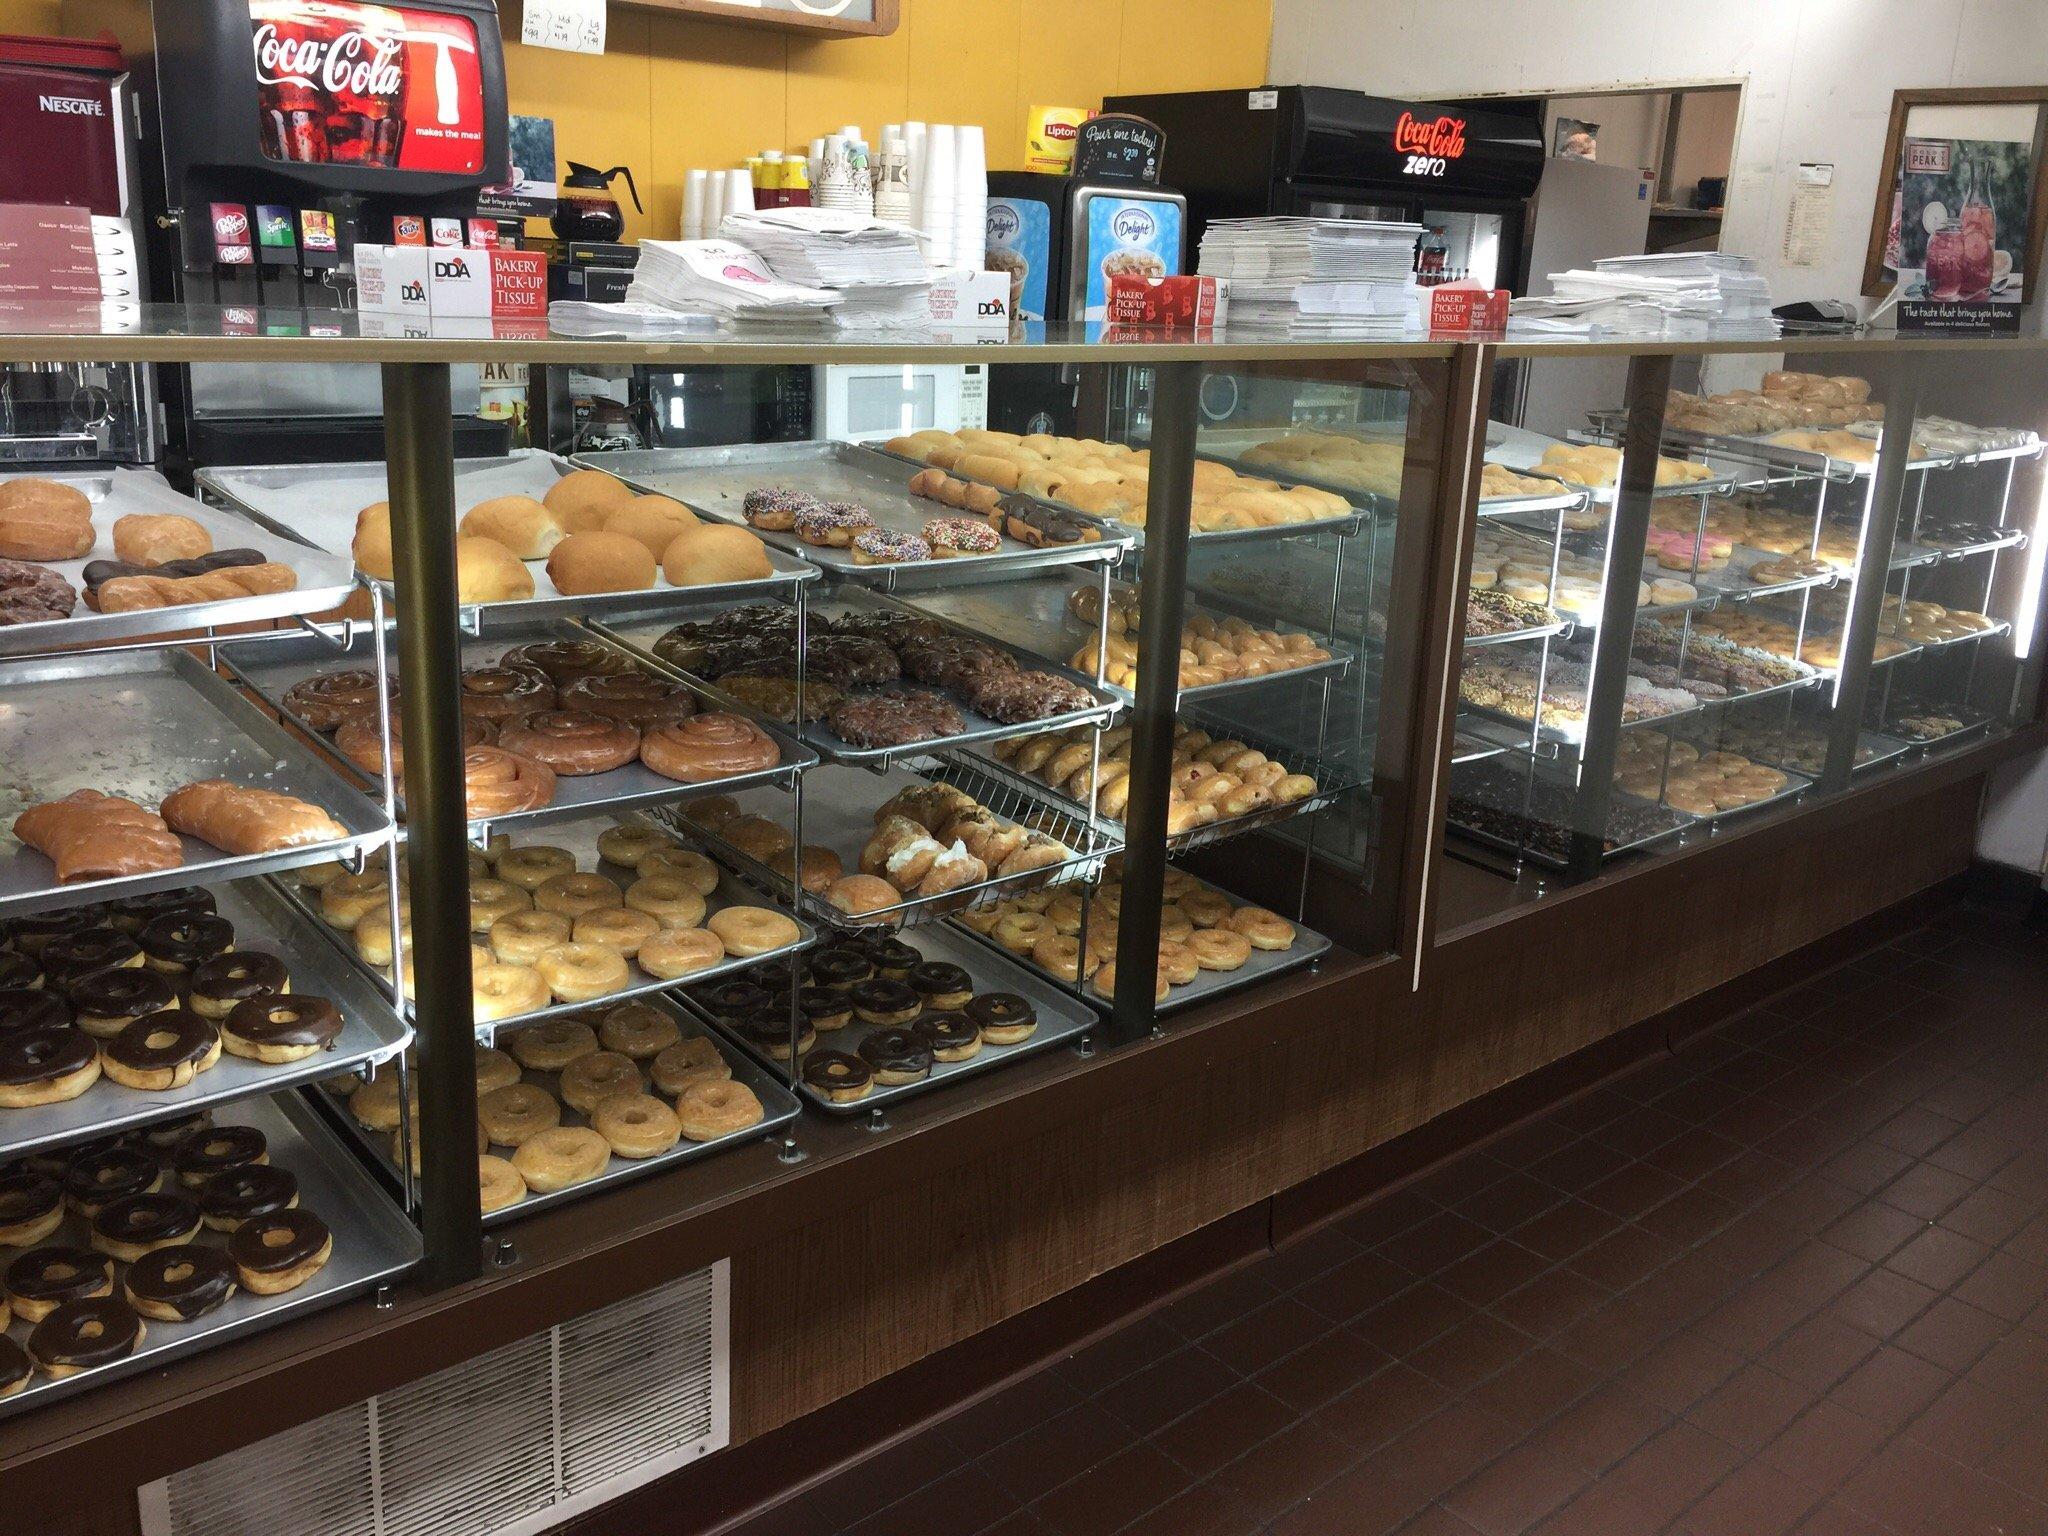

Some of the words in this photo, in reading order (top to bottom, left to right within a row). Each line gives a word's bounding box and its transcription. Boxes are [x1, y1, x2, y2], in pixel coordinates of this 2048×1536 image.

[253, 24, 402, 95] Coca-Cola
[39, 95, 106, 116] NESCAFÉ
[415, 127, 443, 138] makes
[445, 129, 459, 138] the
[460, 131, 482, 140] meal
[1047, 125, 1076, 137] Lipton
[1394, 112, 1466, 158] Coca-Cola
[1086, 126, 1111, 143] Pour
[1113, 129, 1130, 141] one
[1131, 128, 1158, 156] today!
[1912, 154, 1938, 166] PEAK
[435, 227, 460, 239] Coke
[1119, 222, 1151, 241] Delight
[434, 262, 472, 279] DDA
[494, 257, 539, 274] BAKERY
[496, 274, 544, 290] PICK-UP
[606, 283, 627, 291] Fresh
[401, 284, 427, 302] DDA
[495, 290, 537, 305] TISSUE
[1116, 290, 1145, 300] BAKERY
[1435, 294, 1465, 303] BAKERY
[978, 302, 1006, 316] DDA
[1115, 299, 1147, 309] PICK-UP
[1434, 303, 1467, 313] PICK-UP
[1115, 307, 1141, 318] TISSUE
[1433, 312, 1461, 323] TISSUE
[1903, 303, 1918, 317] The
[1919, 306, 1938, 317] taste
[1939, 303, 1957, 318] that
[1957, 305, 1978, 322] brings
[1977, 310, 1992, 322] you
